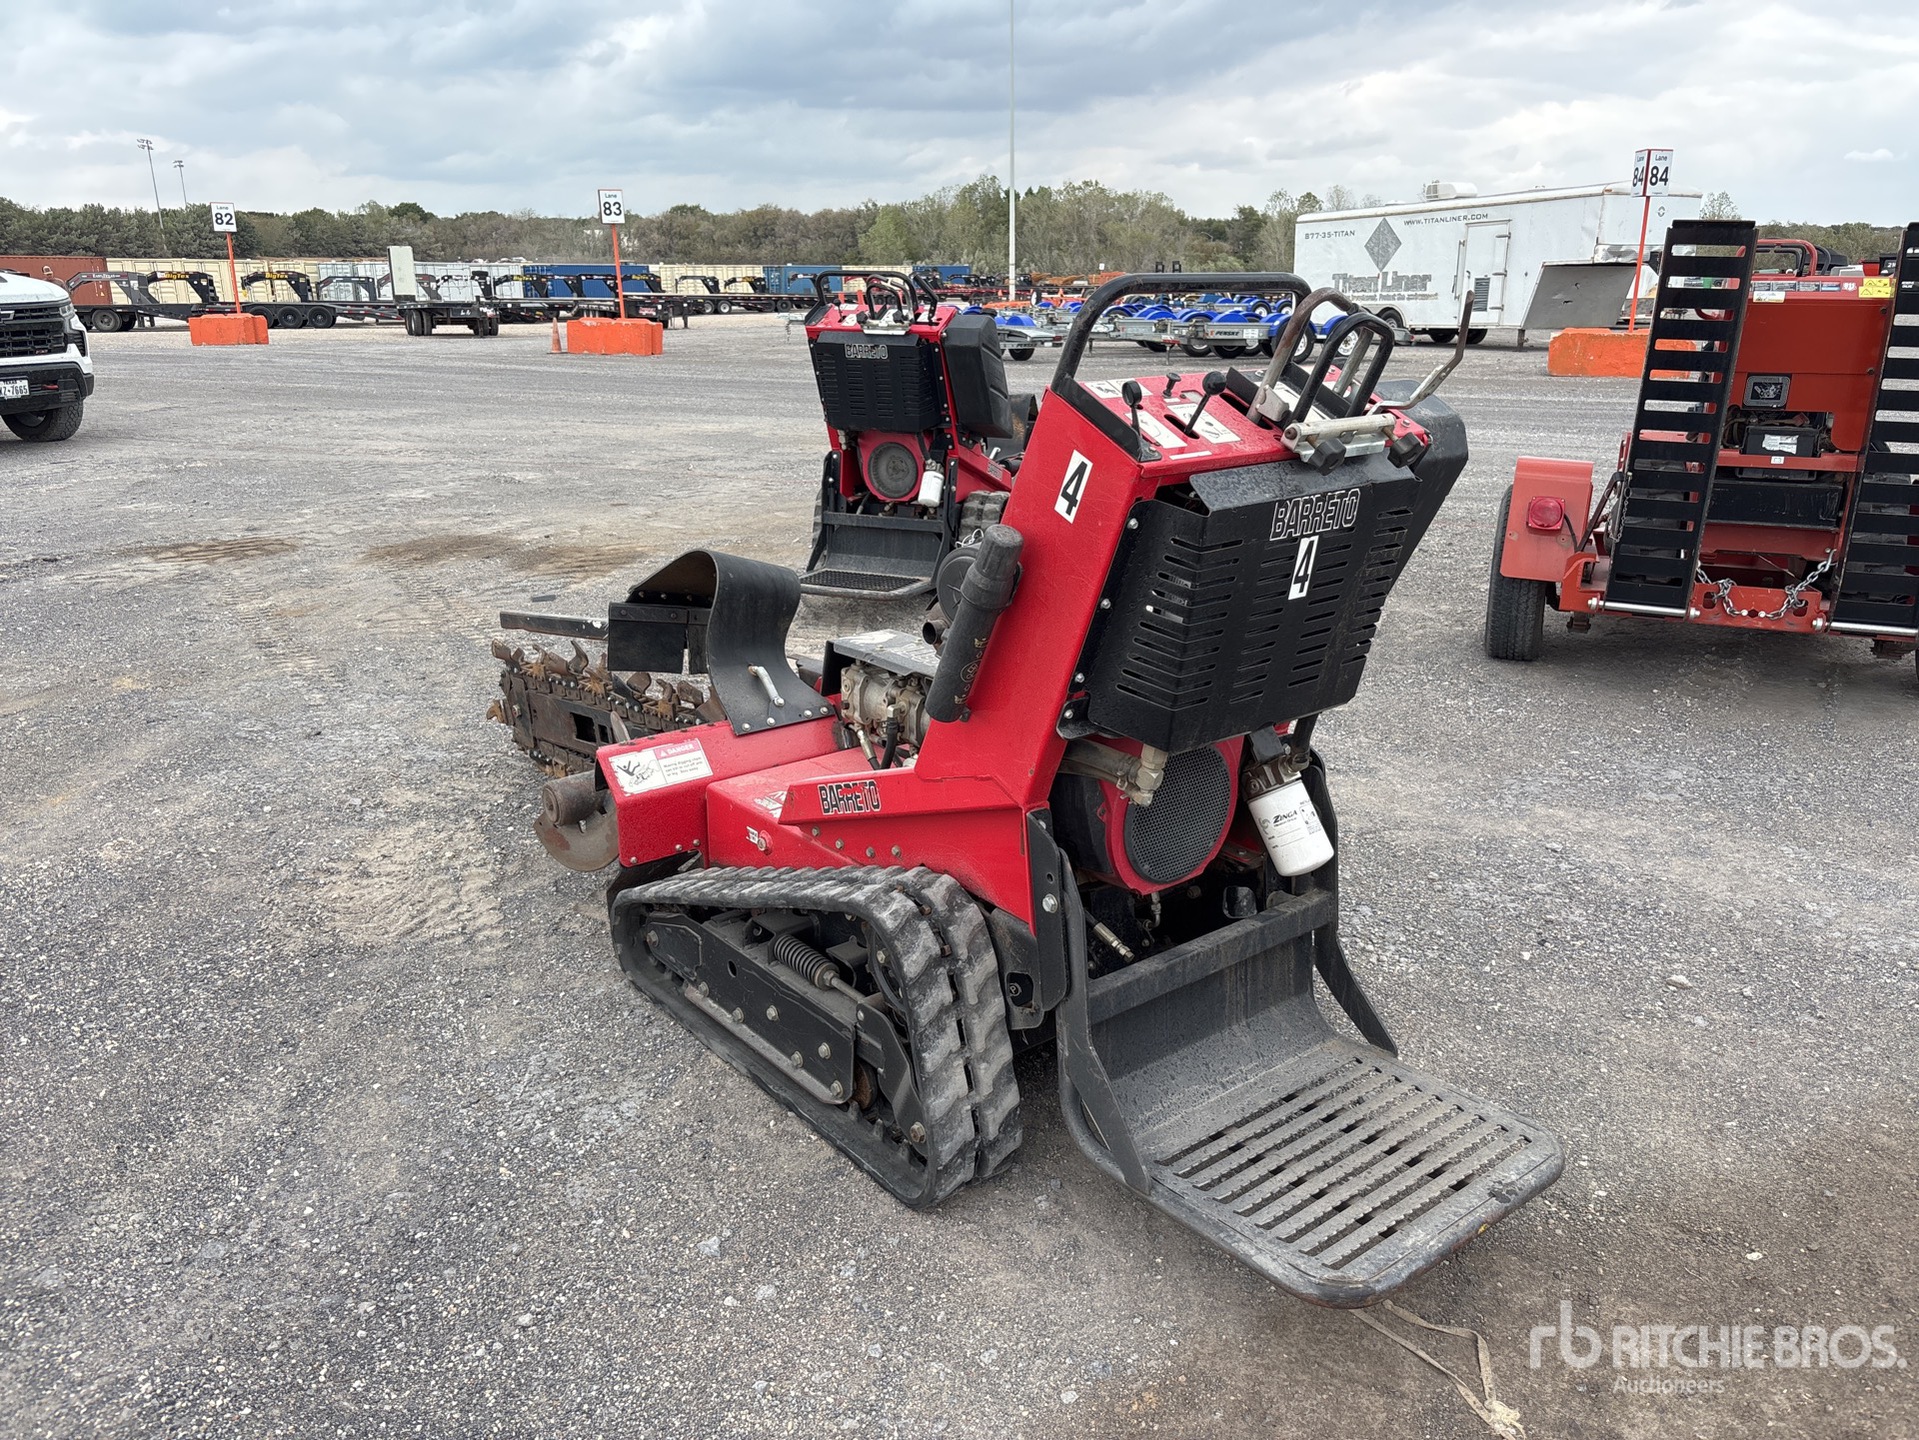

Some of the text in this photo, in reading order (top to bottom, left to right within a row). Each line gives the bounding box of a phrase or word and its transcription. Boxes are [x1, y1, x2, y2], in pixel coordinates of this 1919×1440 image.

[1632, 166, 1645, 187] 84
[1649, 165, 1669, 187] 84
[214, 212, 234, 225] 82
[603, 201, 622, 216] 83
[1403, 213, 1489, 226] WWW.TITANLINER.COM
[1305, 230, 1356, 240] 877-35-TITAN
[1332, 271, 1432, 293] Titan Liner
[844, 343, 888, 360] BARRETO
[1061, 461, 1088, 516] 4
[1269, 488, 1361, 541] BARRETO
[1293, 540, 1316, 594] 4
[667, 744, 695, 754] DANGER
[818, 779, 882, 815] BARRETO
